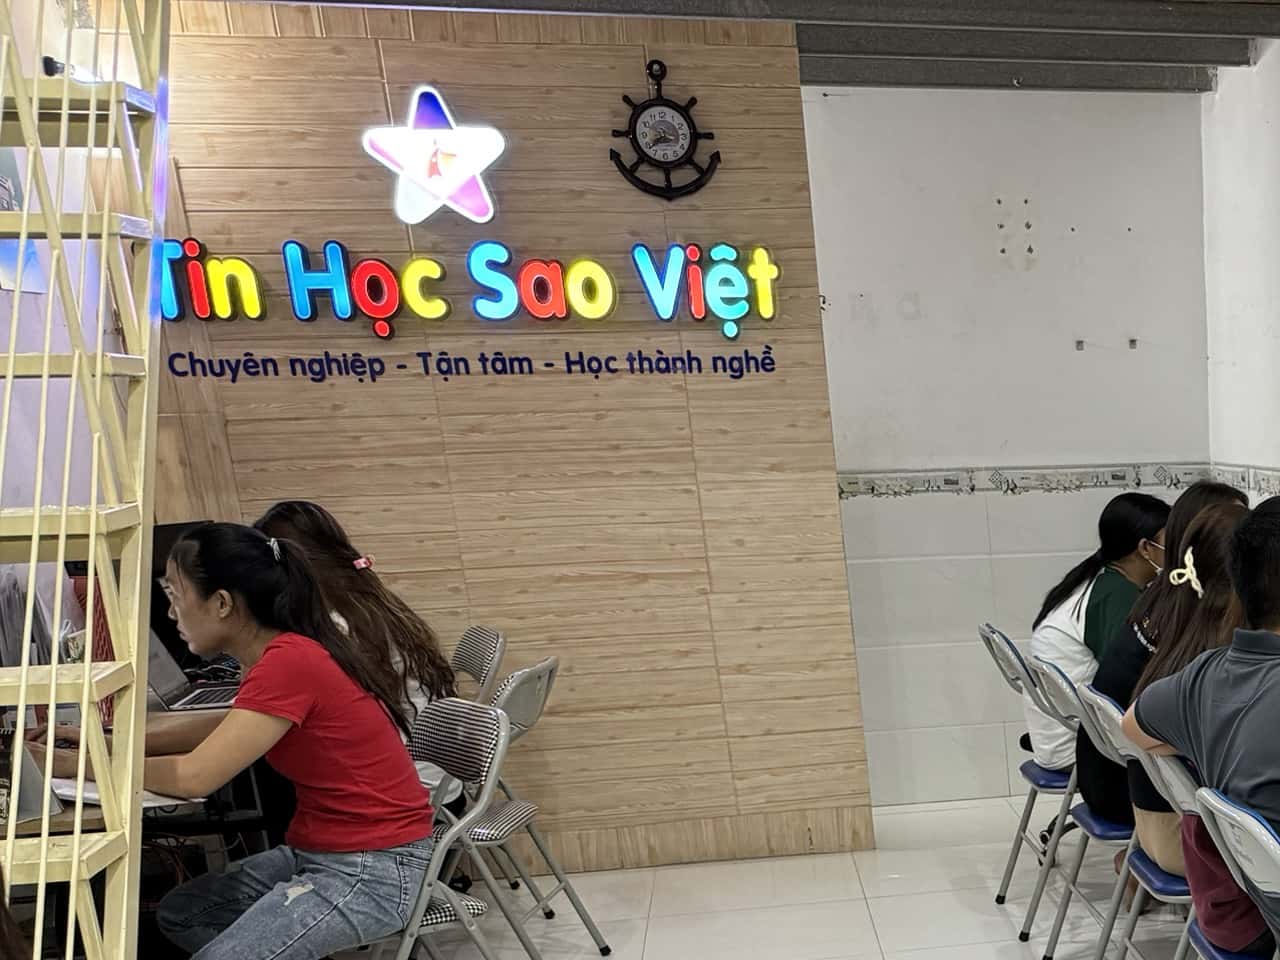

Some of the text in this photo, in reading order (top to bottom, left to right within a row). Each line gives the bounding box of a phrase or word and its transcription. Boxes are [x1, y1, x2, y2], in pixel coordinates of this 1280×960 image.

[160, 238, 782, 340] Tin Học Sao Việt
[168, 351, 279, 383] Chuyên
[289, 351, 386, 383] nghiệp
[416, 351, 471, 382] Tận
[478, 351, 534, 375] tâm
[564, 351, 619, 380] Học
[626, 349, 703, 375] thành
[712, 344, 777, 380] nghề
